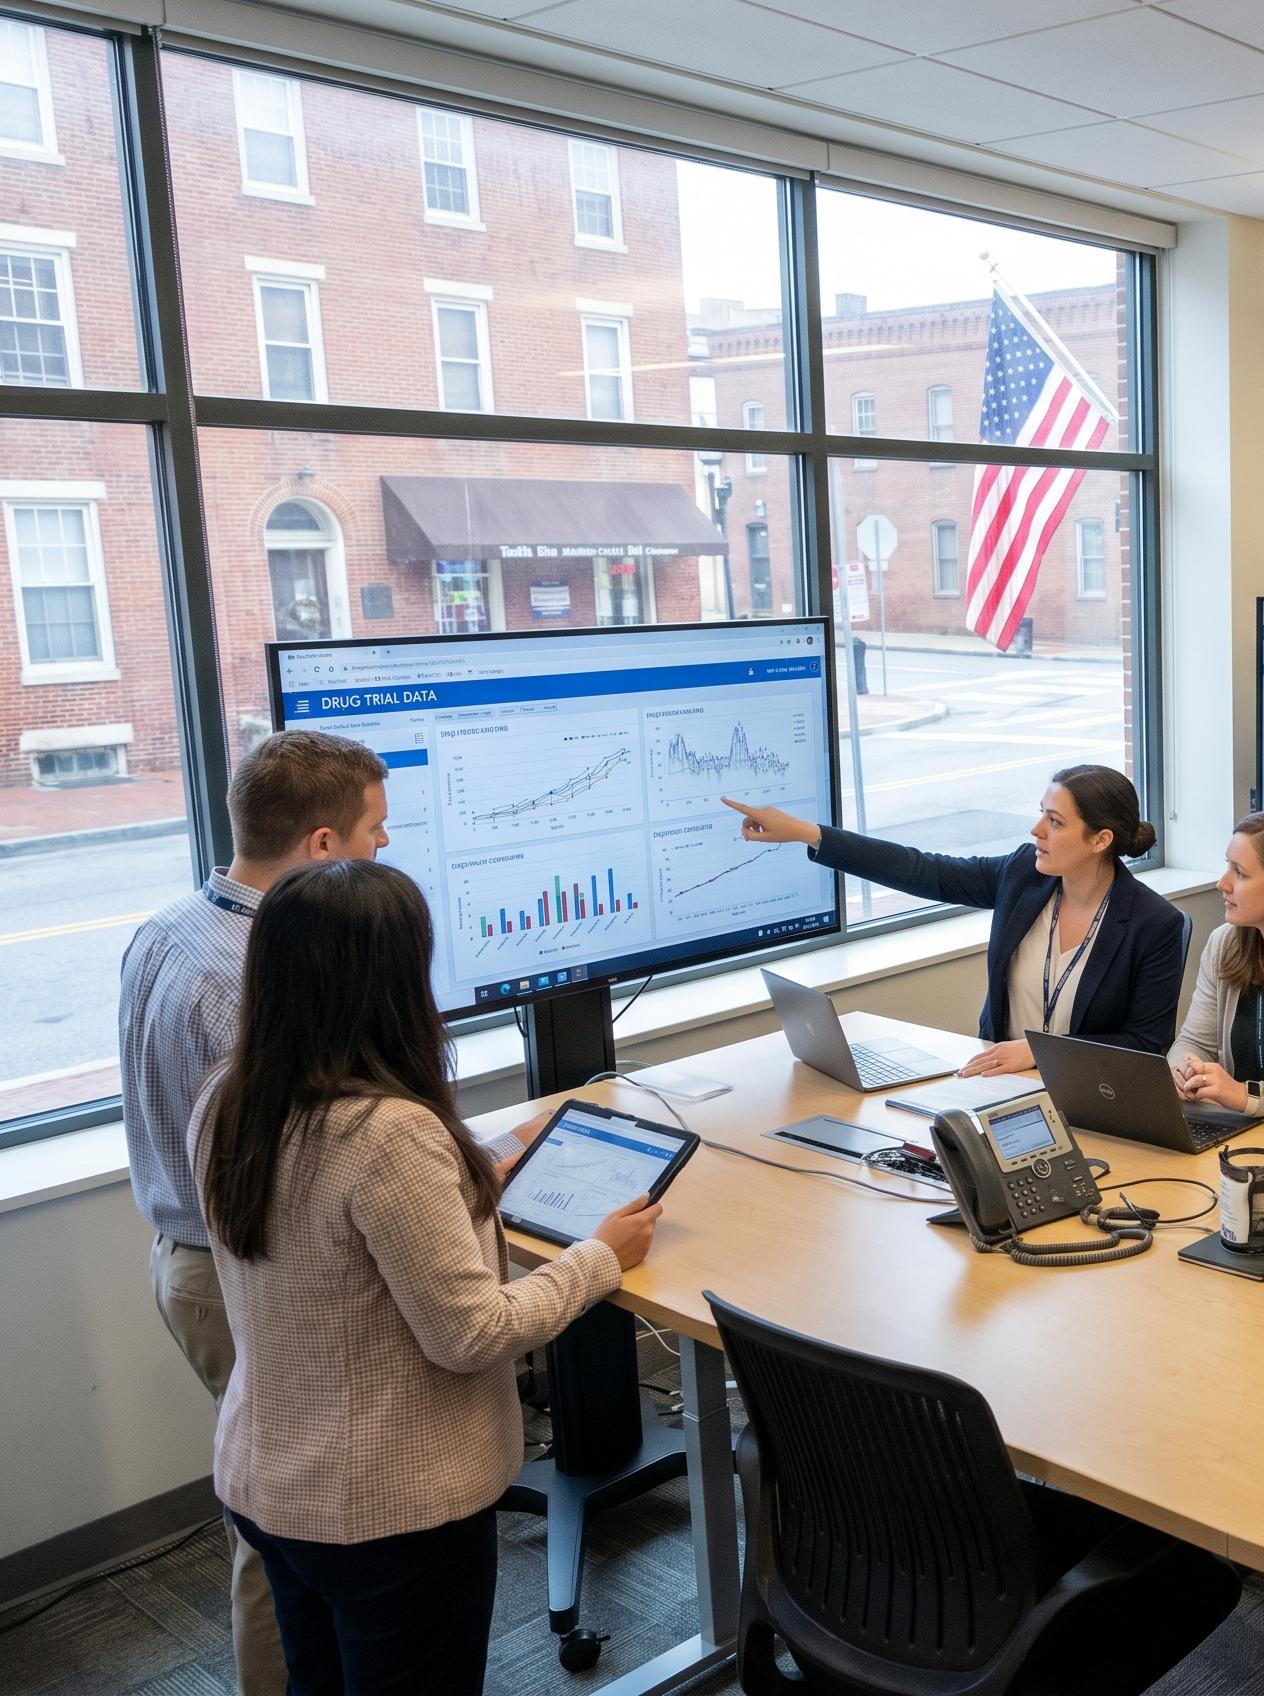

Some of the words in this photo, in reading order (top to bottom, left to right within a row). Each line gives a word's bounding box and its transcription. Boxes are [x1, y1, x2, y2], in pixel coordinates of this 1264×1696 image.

[321, 694, 360, 709] DRUG
[364, 692, 400, 706] TRIAL
[403, 690, 437, 703] DATA
